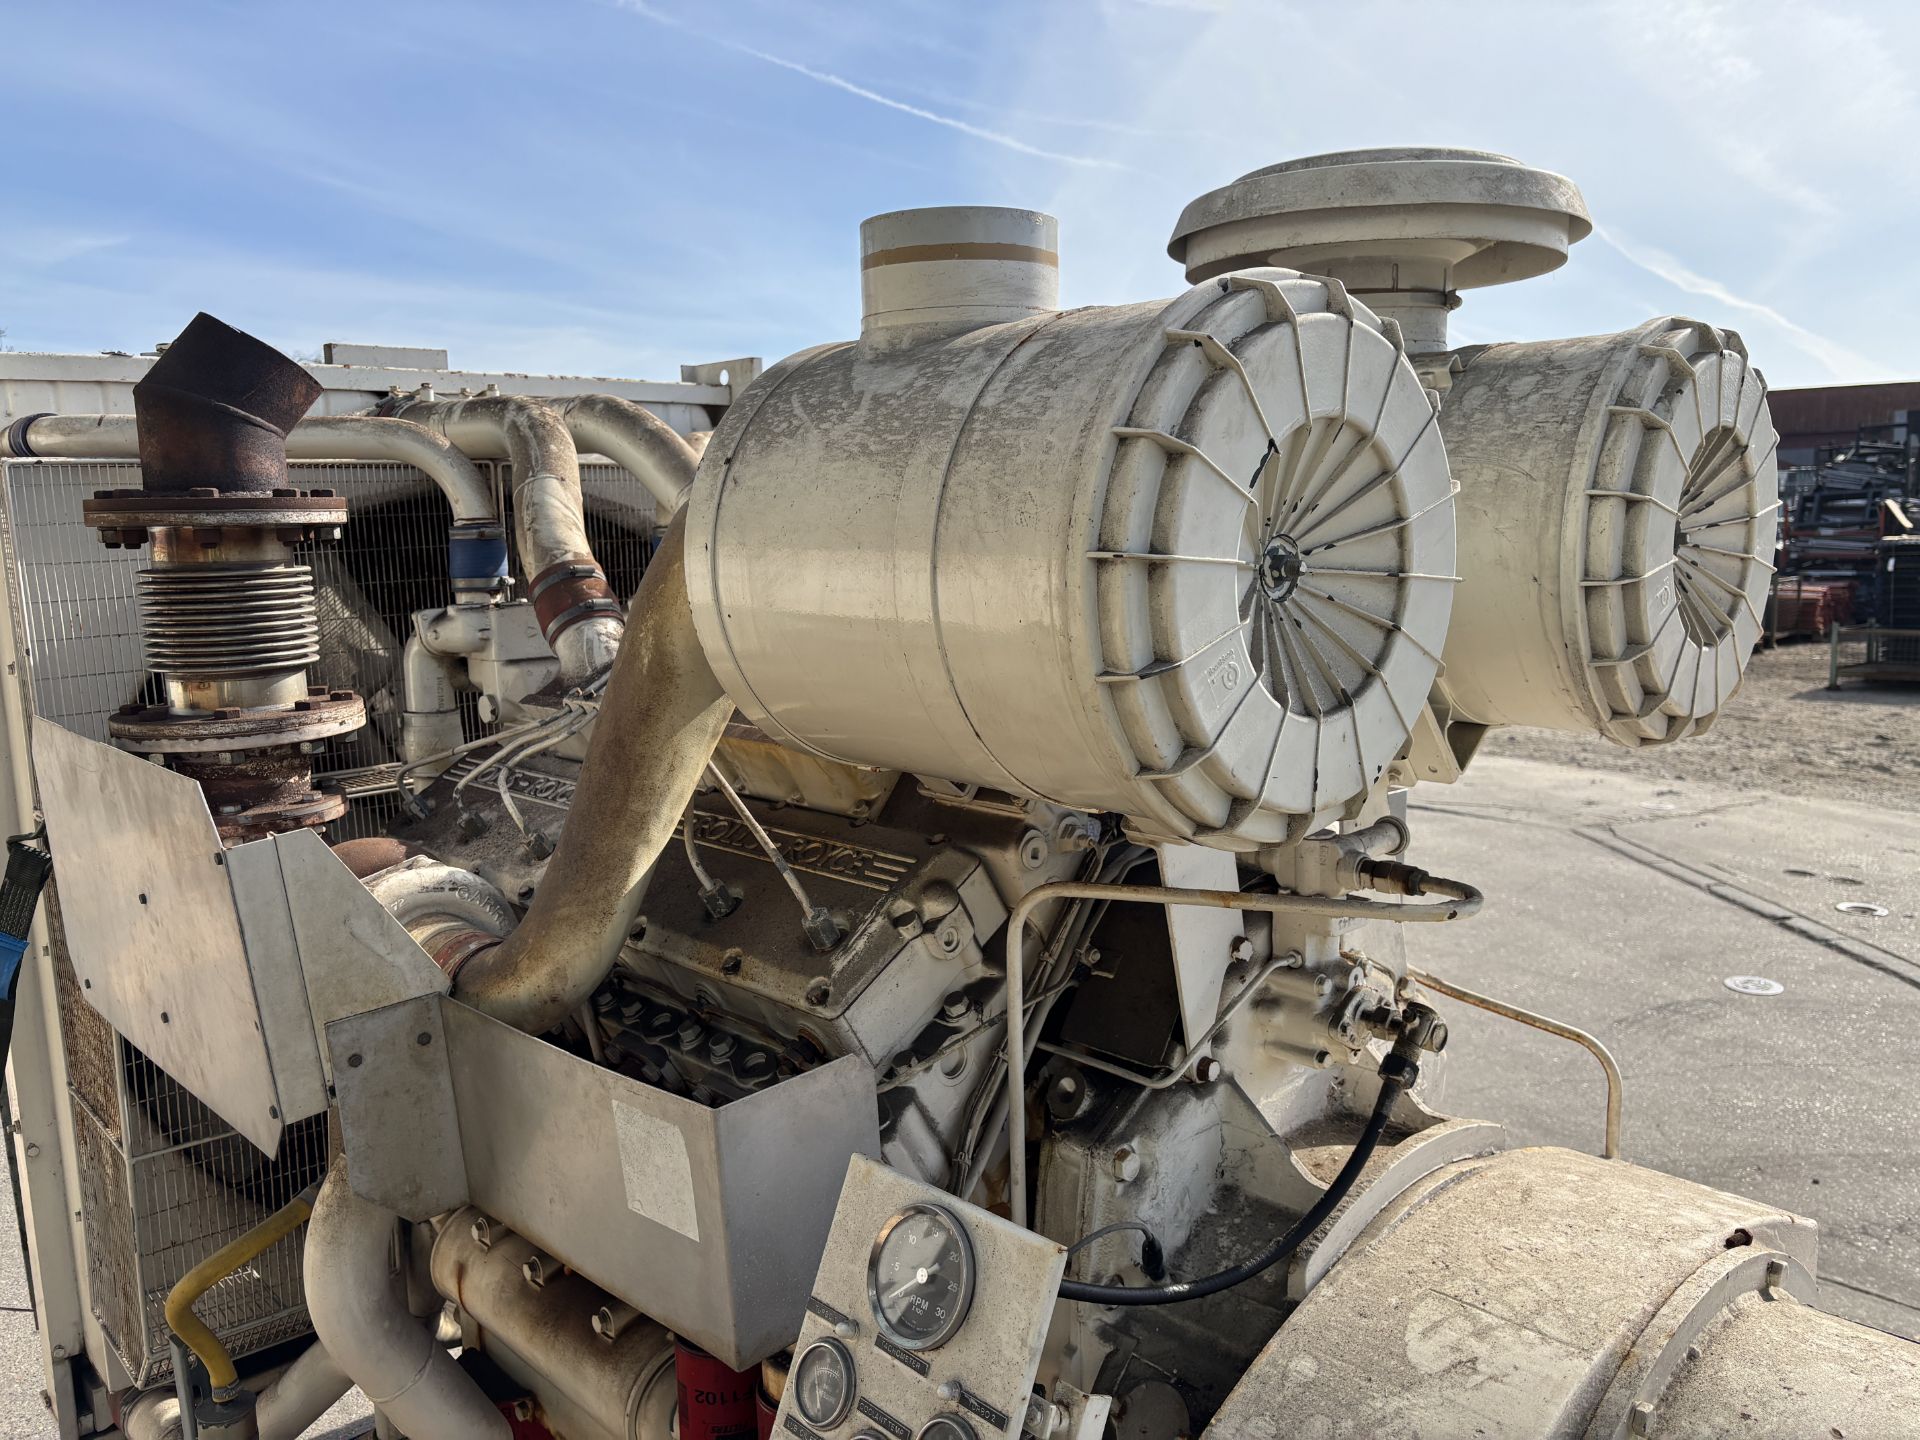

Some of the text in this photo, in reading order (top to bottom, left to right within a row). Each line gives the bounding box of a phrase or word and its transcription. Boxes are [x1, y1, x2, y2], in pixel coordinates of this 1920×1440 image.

[909, 1235, 917, 1245] 10
[950, 1252, 960, 1262] 20
[894, 1262, 900, 1271] 5
[947, 1281, 958, 1292] 25
[910, 1295, 928, 1310] RPM
[935, 1307, 946, 1319] 30
[880, 1341, 921, 1368] TACHOMETER
[968, 1398, 996, 1422] TURBO 2
[859, 1402, 904, 1436] COOLANT TEMP
